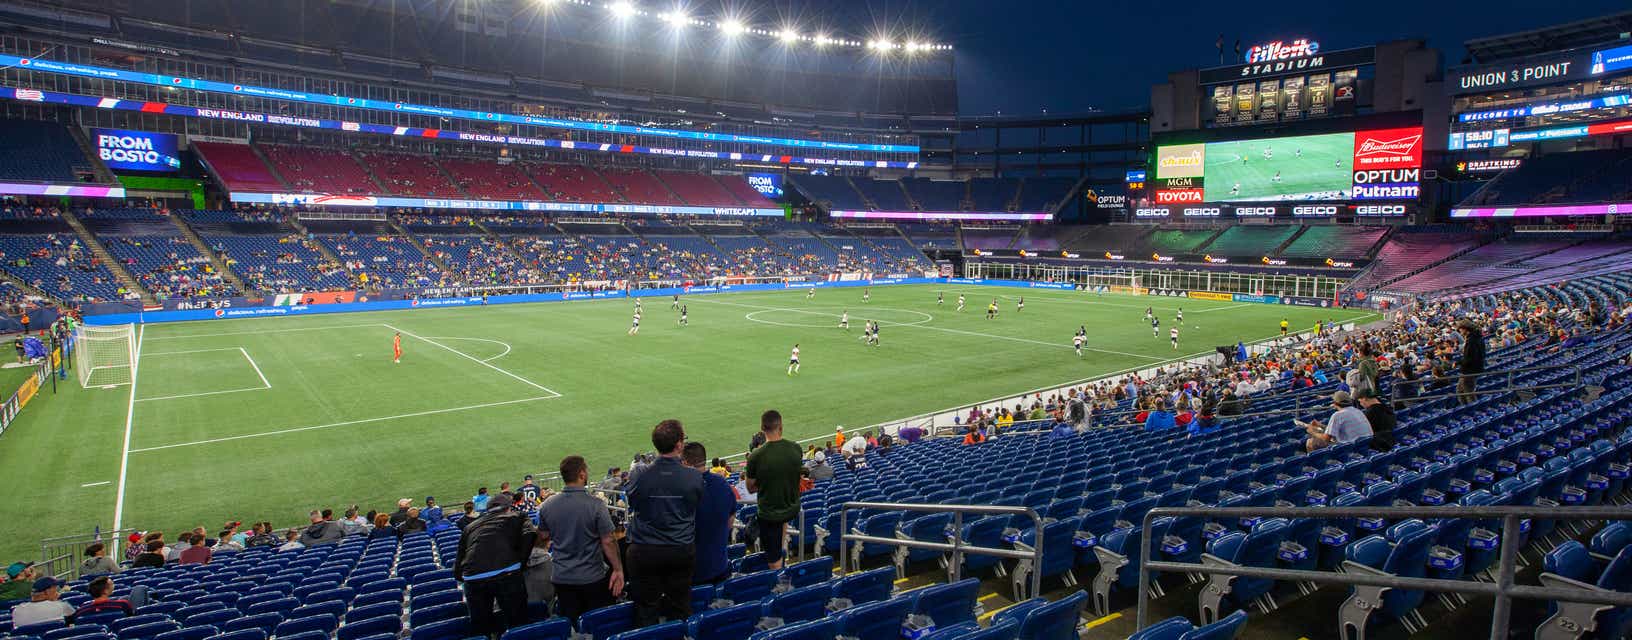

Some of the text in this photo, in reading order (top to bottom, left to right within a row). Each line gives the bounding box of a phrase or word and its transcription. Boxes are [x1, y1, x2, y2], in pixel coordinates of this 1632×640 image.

[1245, 39, 1319, 64] Gillette
[1241, 57, 1324, 76] STADIUM
[1461, 62, 1571, 88] UNION 3 POINT
[198, 108, 320, 128] NEW ENGLAND REVOLUTION
[1464, 111, 1509, 121] WELCOME
[98, 134, 153, 150] FROM
[460, 133, 546, 146] NEW ENGLAND REVOLUTION
[1465, 131, 1493, 142] 58:10
[1363, 140, 1414, 152] Budweiser
[1468, 160, 1521, 168] DRAFTKINGS
[749, 176, 772, 186] FROM
[1167, 178, 1193, 186] MGM
[1354, 169, 1419, 184] OPTUM
[1158, 191, 1202, 202] TOYOTA
[1352, 185, 1419, 198] Putnam
[1097, 195, 1125, 204] OPTUM
[714, 208, 755, 216] WHITECAPS
[1136, 208, 1170, 216] GEICO
[1184, 208, 1220, 216] GEICO
[1236, 207, 1276, 216] GEICO
[1293, 206, 1337, 215] GEICO
[1356, 205, 1406, 215] GEICO
[524, 491, 536, 502] 10
[1559, 618, 1577, 631] 22
